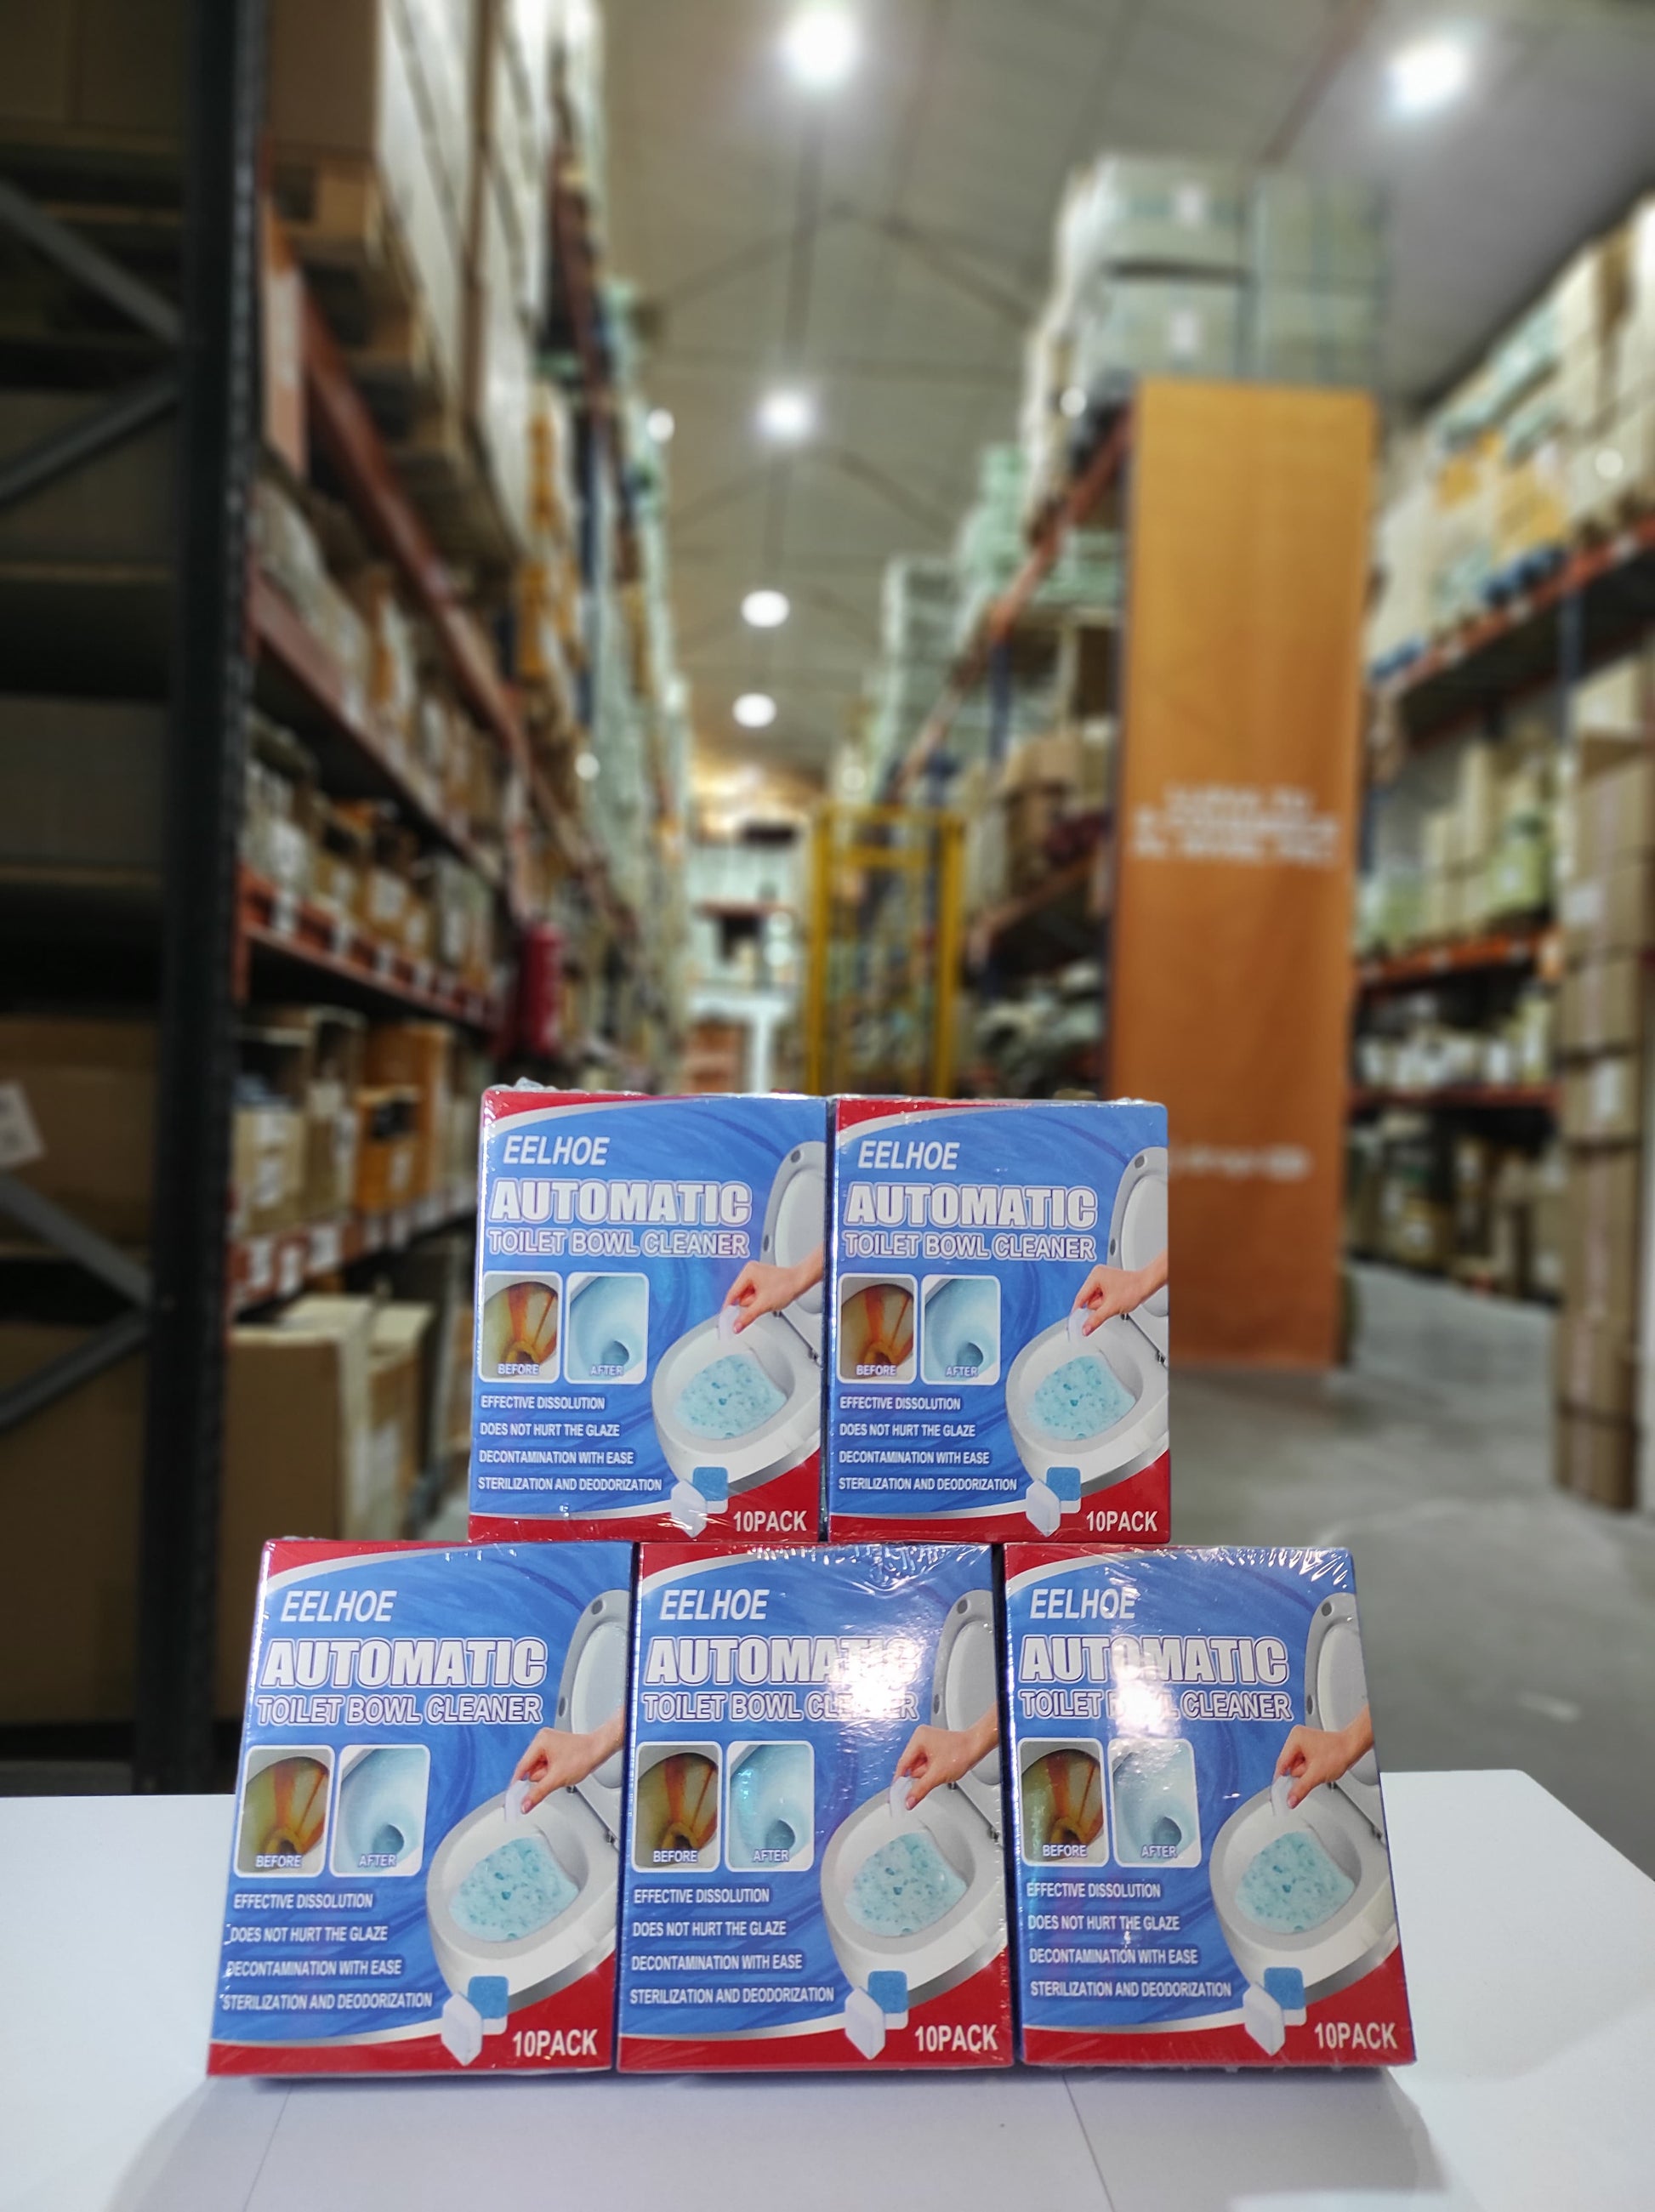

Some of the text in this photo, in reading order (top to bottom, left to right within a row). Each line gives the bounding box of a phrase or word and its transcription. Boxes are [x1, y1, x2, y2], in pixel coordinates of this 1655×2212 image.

[503, 1135, 610, 1165] EELHOE
[857, 1140, 959, 1170] EELHOE
[488, 1178, 753, 1226] AUTOMATIC
[845, 1181, 1098, 1230] AUTOMATIC
[487, 1227, 751, 1259] TOILET BOWL CLEANER
[842, 1231, 1096, 1260] TOILET BOWL CLEANER
[498, 1364, 539, 1375] BEFORE
[590, 1365, 623, 1375] AFTER
[856, 1365, 896, 1376] BEFORE
[946, 1366, 977, 1377] AFTER
[481, 1395, 606, 1410] EFFECTIVE DISSOLUTION
[839, 1396, 961, 1410] EFFECTIVE DISSOLUTION
[480, 1423, 620, 1437] DOES NOT HURT THE GLAZE
[839, 1424, 975, 1437] DOES NOT HURT THE GLAZE
[479, 1450, 634, 1464] DECONTAMINATION WITH EASE
[839, 1451, 989, 1464] DECONTAMINATION WITH EASE
[478, 1476, 663, 1491] STERILIZATION AND DEODORIZATION
[839, 1477, 1016, 1491] STERILIZATION AND DEODORIZATION
[732, 1510, 807, 1532] 10PACK
[1086, 1510, 1158, 1532] 10PACK
[280, 1589, 397, 1622] EELHOE
[660, 1589, 769, 1621] EELHOE
[1029, 1589, 1136, 1619] EELHOE
[260, 1637, 549, 1688] AUTOMATIC
[1018, 1634, 1289, 1686] AUTOMATIC
[256, 1695, 543, 1726] TOILET BOWL CLEANER
[643, 1692, 727, 1721] TOILET
[730, 1692, 803, 1721] BOWL
[1019, 1689, 1102, 1718] TOILET
[1180, 1691, 1294, 1720] CLEANER
[653, 1850, 698, 1862] BEFORE
[754, 1850, 789, 1862] AFTER
[1043, 1845, 1087, 1857] BEFORE
[1141, 1845, 1177, 1858] AFTER
[255, 1855, 302, 1868] BEFORE
[359, 1854, 397, 1867] AFTER
[634, 1889, 770, 1903] EFFECTIVE DISSOLUTION
[1027, 1883, 1161, 1897] EFFECTIVE DISSOLUTION
[234, 1893, 373, 1909] EFFECTIVE DISSOLUTION
[633, 1921, 786, 1936] DOES NOT HURT THE GLAZE
[1028, 1915, 1180, 1931] DOES NOT HURT THE GLAZE
[230, 1925, 388, 1942] DOES NOT HURT THE GLAZE
[631, 1954, 802, 1970] DECONTAMINATION WITH EASE
[1029, 1948, 1198, 1964] DECONTAMINATION WITH EASE
[226, 1959, 401, 1977] DECONTAMINATION WITH EASE
[630, 1987, 834, 2004] STERILIZATION AND DEODORIZATION
[1030, 1981, 1231, 1997] STERILIZATION AND DEODORIZATION
[223, 1993, 433, 2010] STERILIZATION AND DEODORIZATION
[513, 2030, 598, 2057] 10PACK
[914, 2025, 998, 2052] 10PACK
[1314, 2022, 1396, 2050] 10PACK
